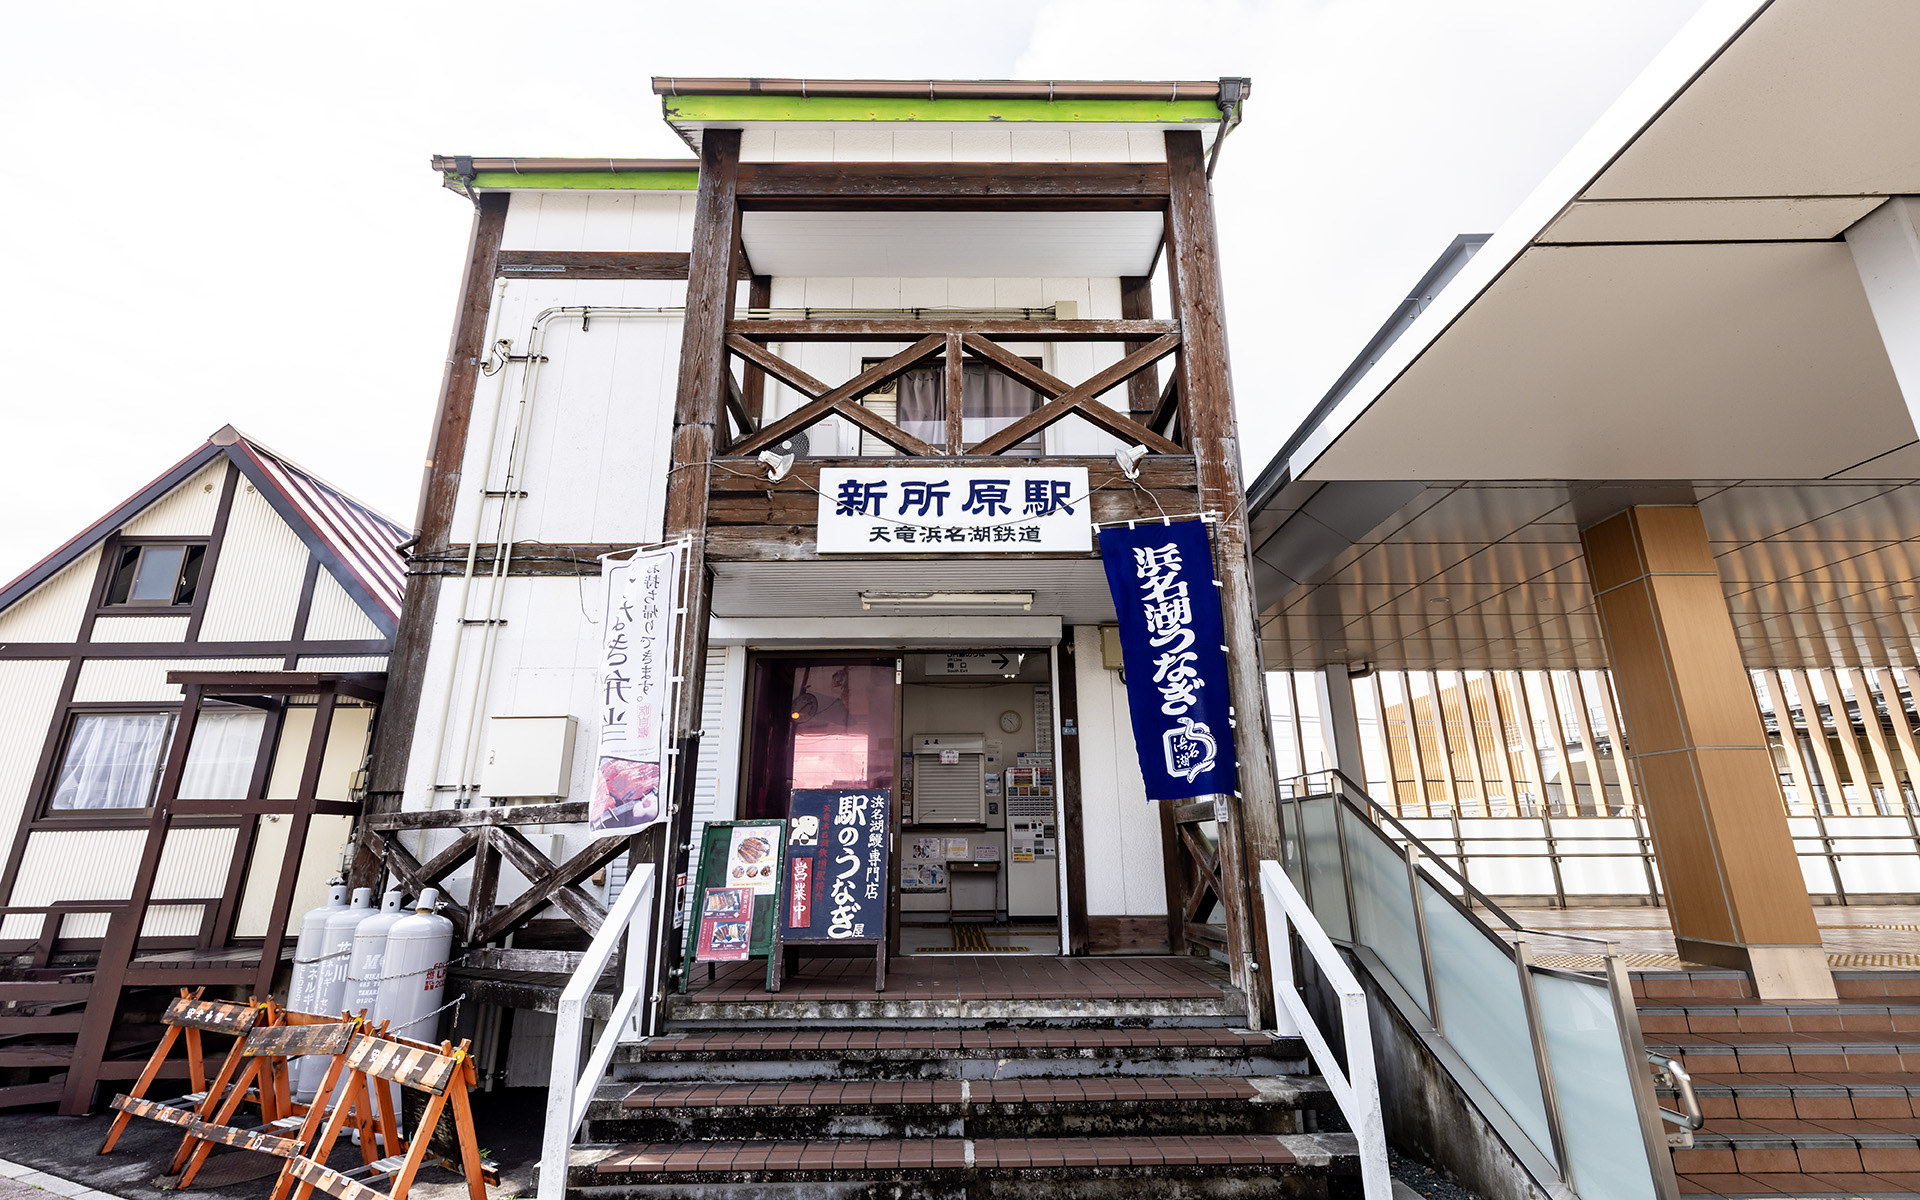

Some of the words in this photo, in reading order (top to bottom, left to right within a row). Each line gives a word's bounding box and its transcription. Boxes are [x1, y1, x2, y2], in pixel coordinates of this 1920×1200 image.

[835, 478, 1075, 517] 新所原駅
[869, 525, 1042, 543] 天竜浜名湖鉄道
[1132, 542, 1206, 716] 浜名湖うなぎ
[827, 794, 869, 939] 駅のうなぎ屋
[864, 794, 885, 900] 浜名湖鰻専門店
[792, 862, 808, 920] 営業中
